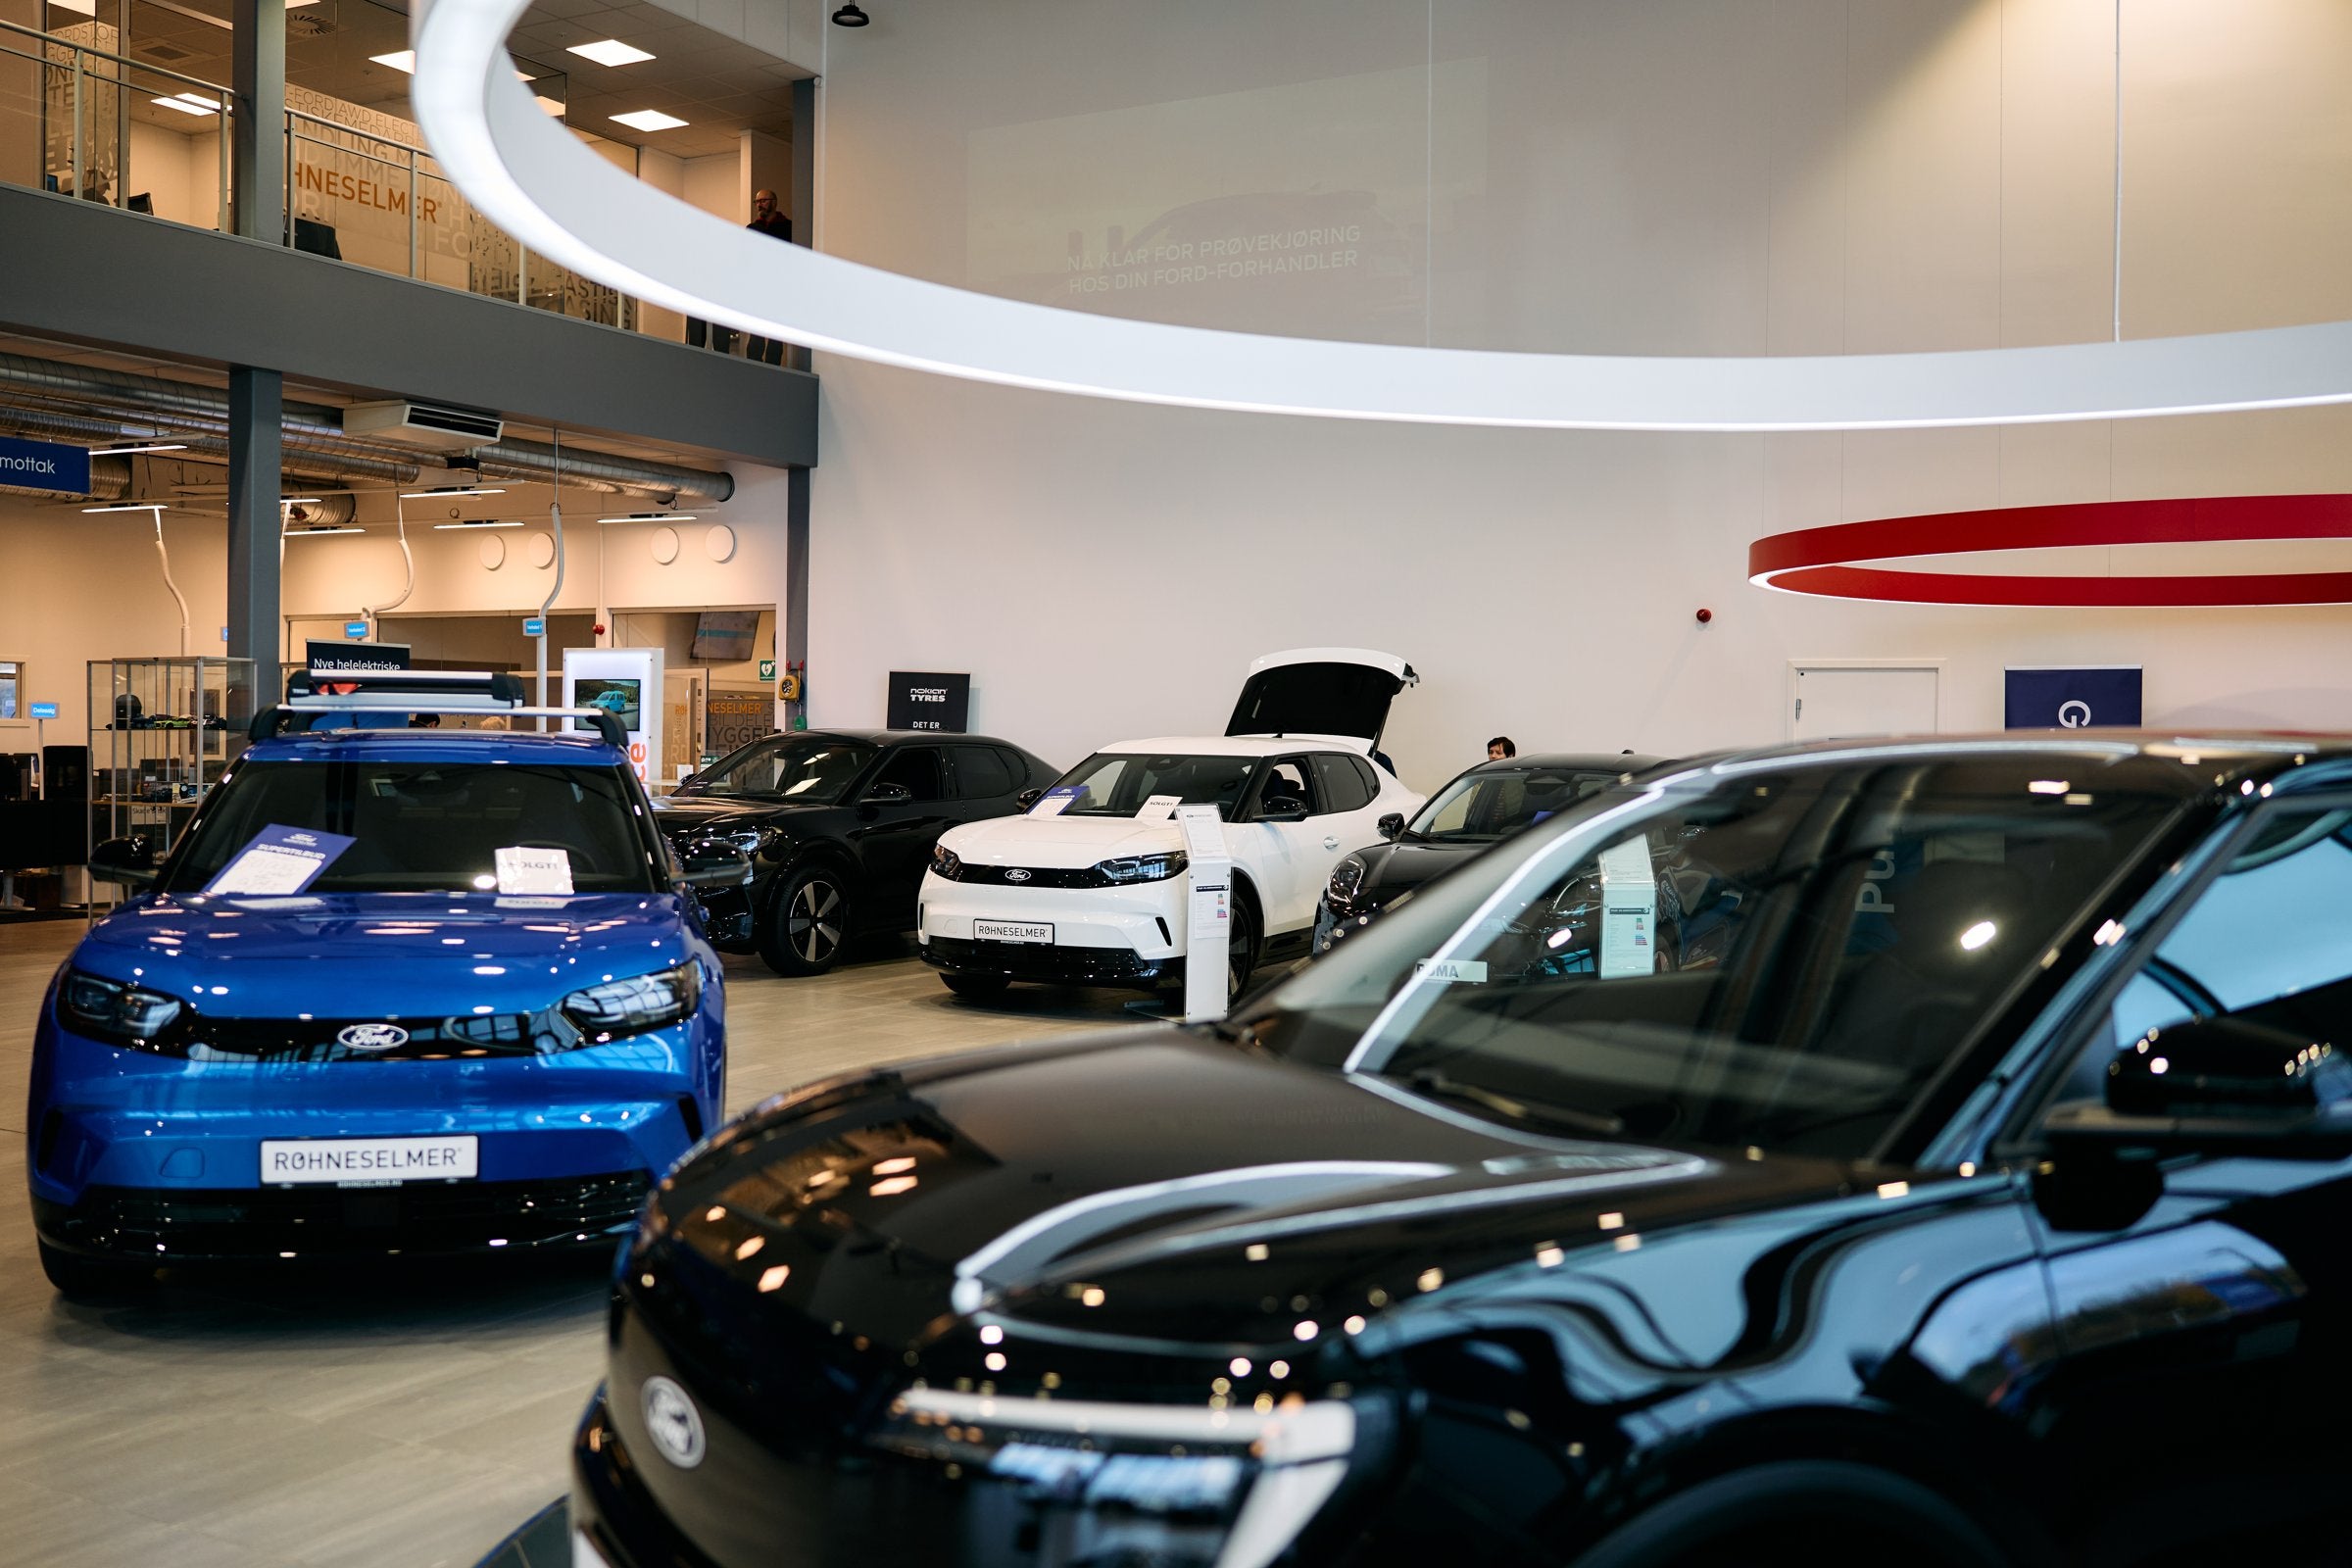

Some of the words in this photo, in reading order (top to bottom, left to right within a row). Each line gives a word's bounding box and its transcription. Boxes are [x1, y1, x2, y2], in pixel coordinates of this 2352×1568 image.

[1100, 249, 1149, 268] KLAR
[1154, 243, 1194, 262] FOR
[1200, 225, 1360, 258] PRØVEKJØRING
[1069, 275, 1109, 293] HOS
[1115, 271, 1147, 290] DIN
[1154, 250, 1357, 285] FORD-FORHANDLER
[314, 658, 334, 670] Nye
[910, 694, 946, 703] TYRES
